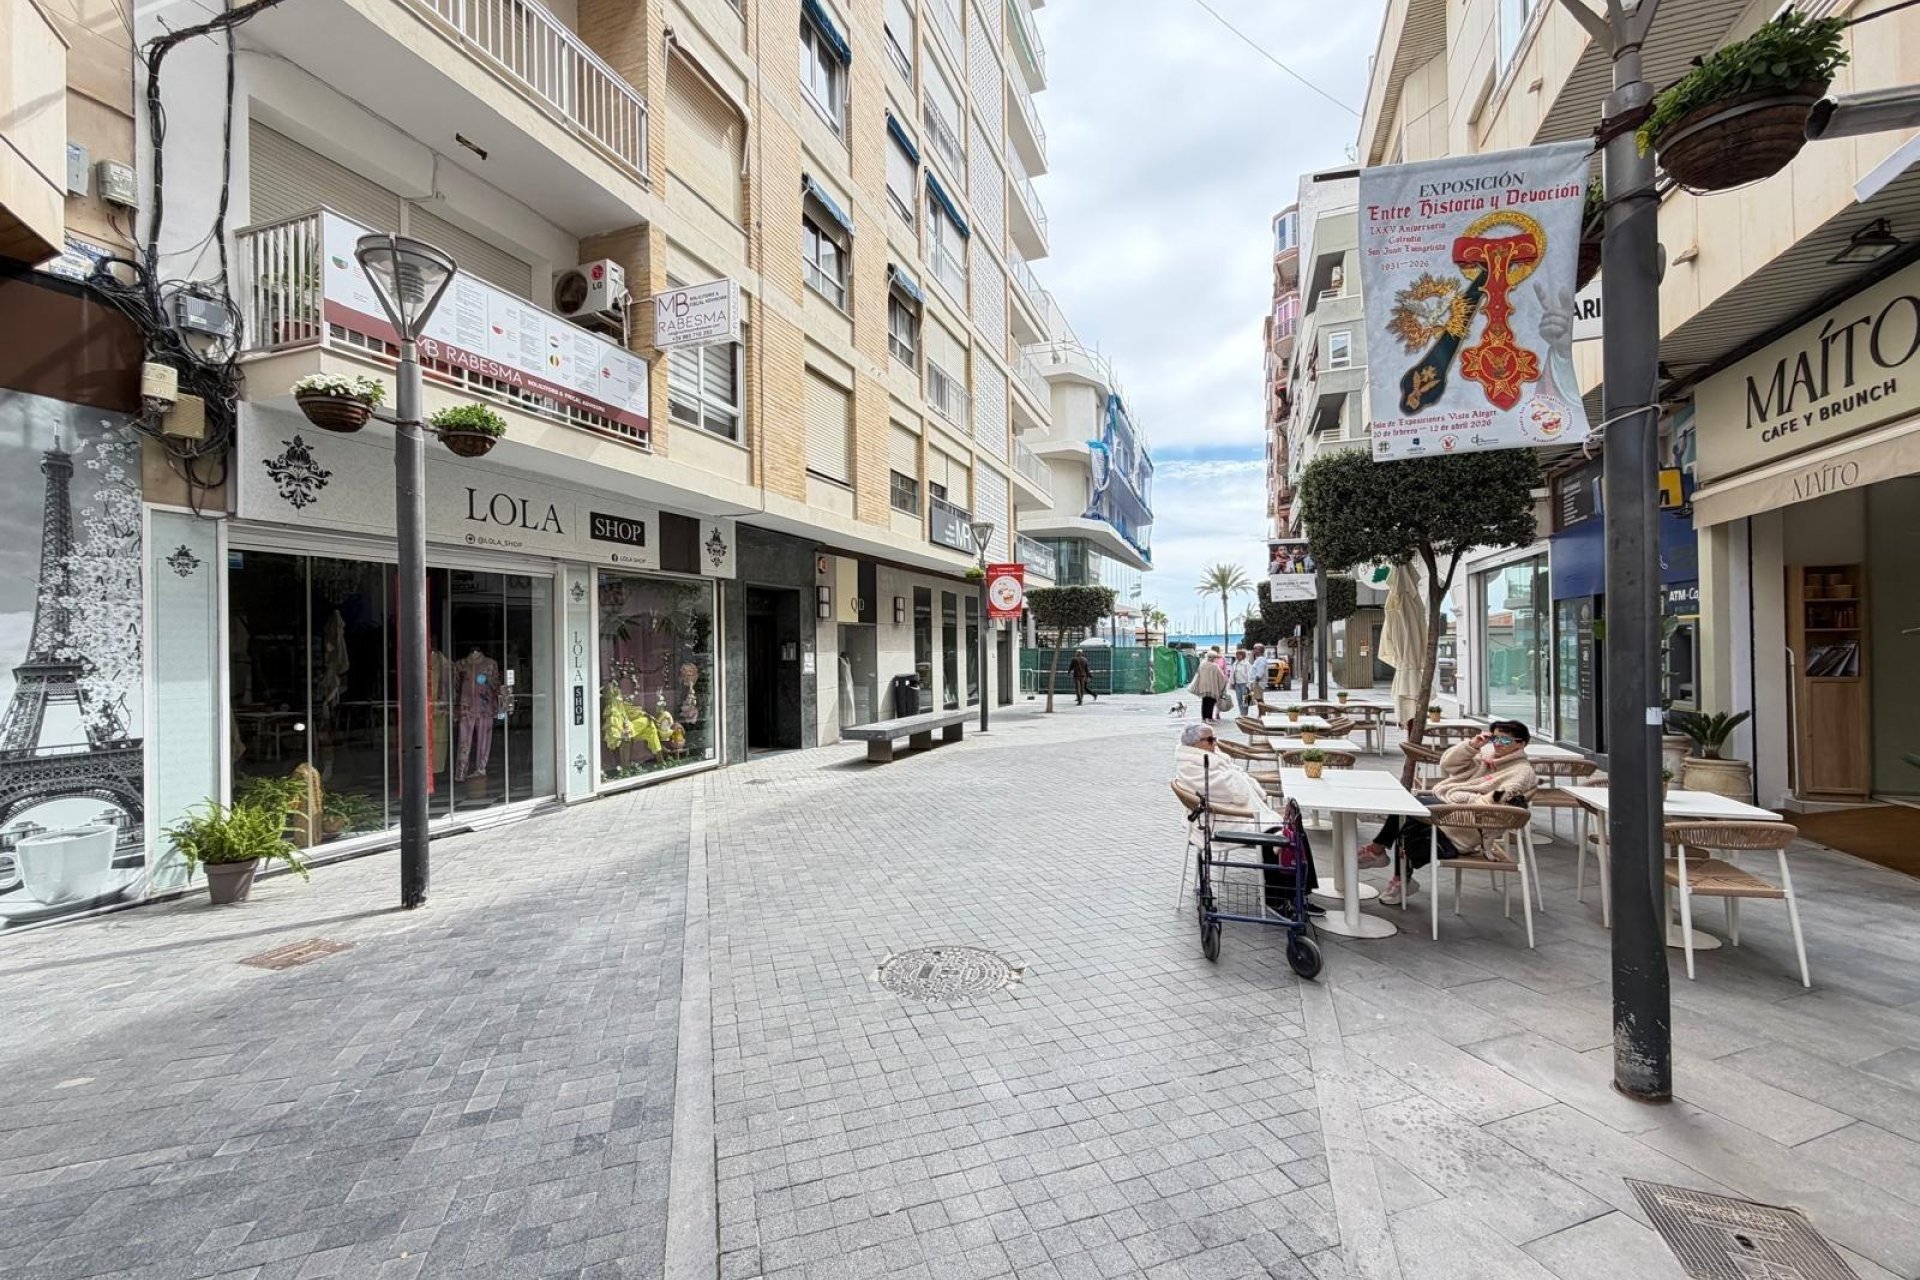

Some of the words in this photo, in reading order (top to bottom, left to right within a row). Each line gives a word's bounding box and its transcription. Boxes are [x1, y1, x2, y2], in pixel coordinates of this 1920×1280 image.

[1419, 171, 1526, 198] EXPOSICIÓN
[1367, 206, 1411, 221] Entre
[1419, 195, 1484, 219] Historia
[1491, 196, 1499, 210] y
[1506, 181, 1580, 205] Devoción
[592, 281, 602, 290] LG
[658, 292, 689, 318] MB
[658, 310, 727, 334] RABESMA
[446, 347, 523, 386] RABESMA
[1746, 296, 1920, 430] MAÍTO
[1398, 416, 1445, 426] Exposiciones
[1447, 413, 1469, 421] Vista
[1470, 419, 1492, 428] 2026
[1761, 418, 1798, 442] CAFE
[1803, 412, 1813, 426] Y
[1819, 378, 1897, 421] BRUNCH
[1792, 461, 1859, 500] MAÍTO
[465, 487, 565, 534] LOLA
[595, 518, 641, 542] SHOP
[1668, 587, 1700, 602] ATM-Ca
[572, 631, 583, 682] LOLA
[575, 686, 583, 724] SHOP
